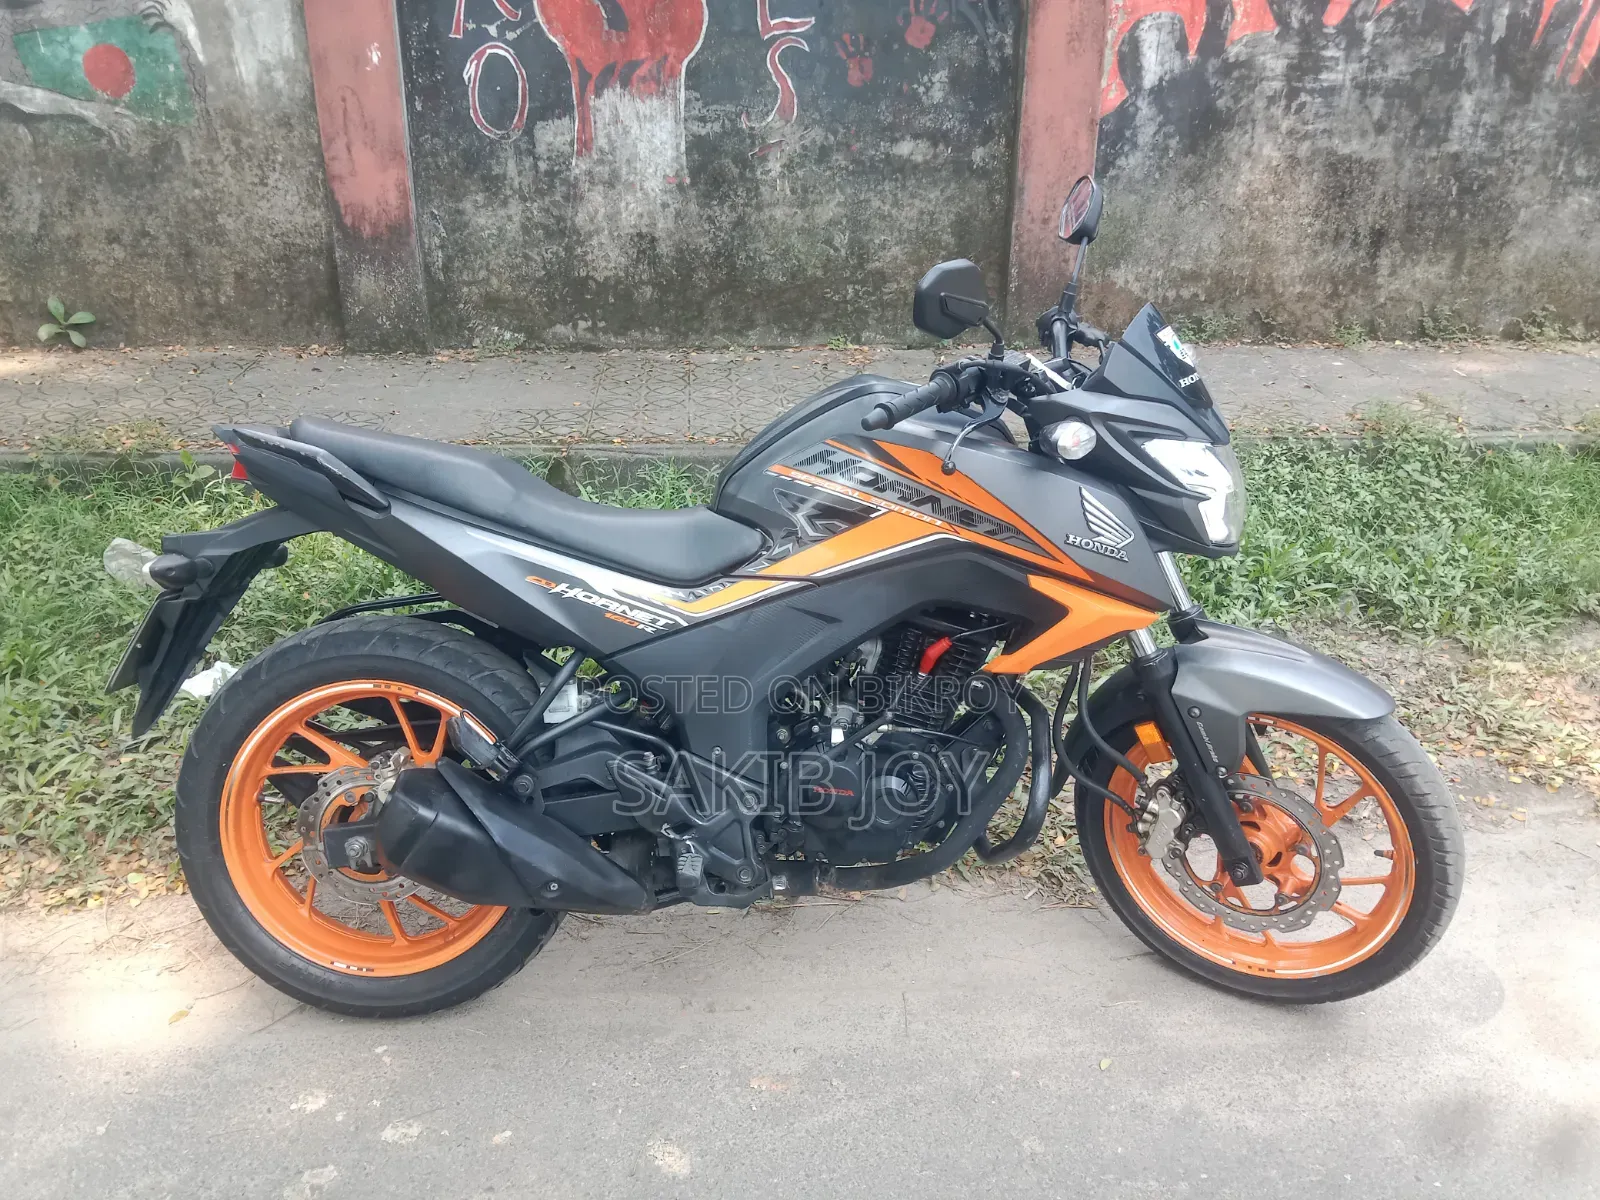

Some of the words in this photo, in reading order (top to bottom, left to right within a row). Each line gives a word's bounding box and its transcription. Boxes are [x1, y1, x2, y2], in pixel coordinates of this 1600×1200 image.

[789, 470, 864, 501] SPECIAL
[868, 497, 943, 526] EDITION
[1064, 533, 1129, 562] HONDA
[548, 583, 675, 628] HORNET
